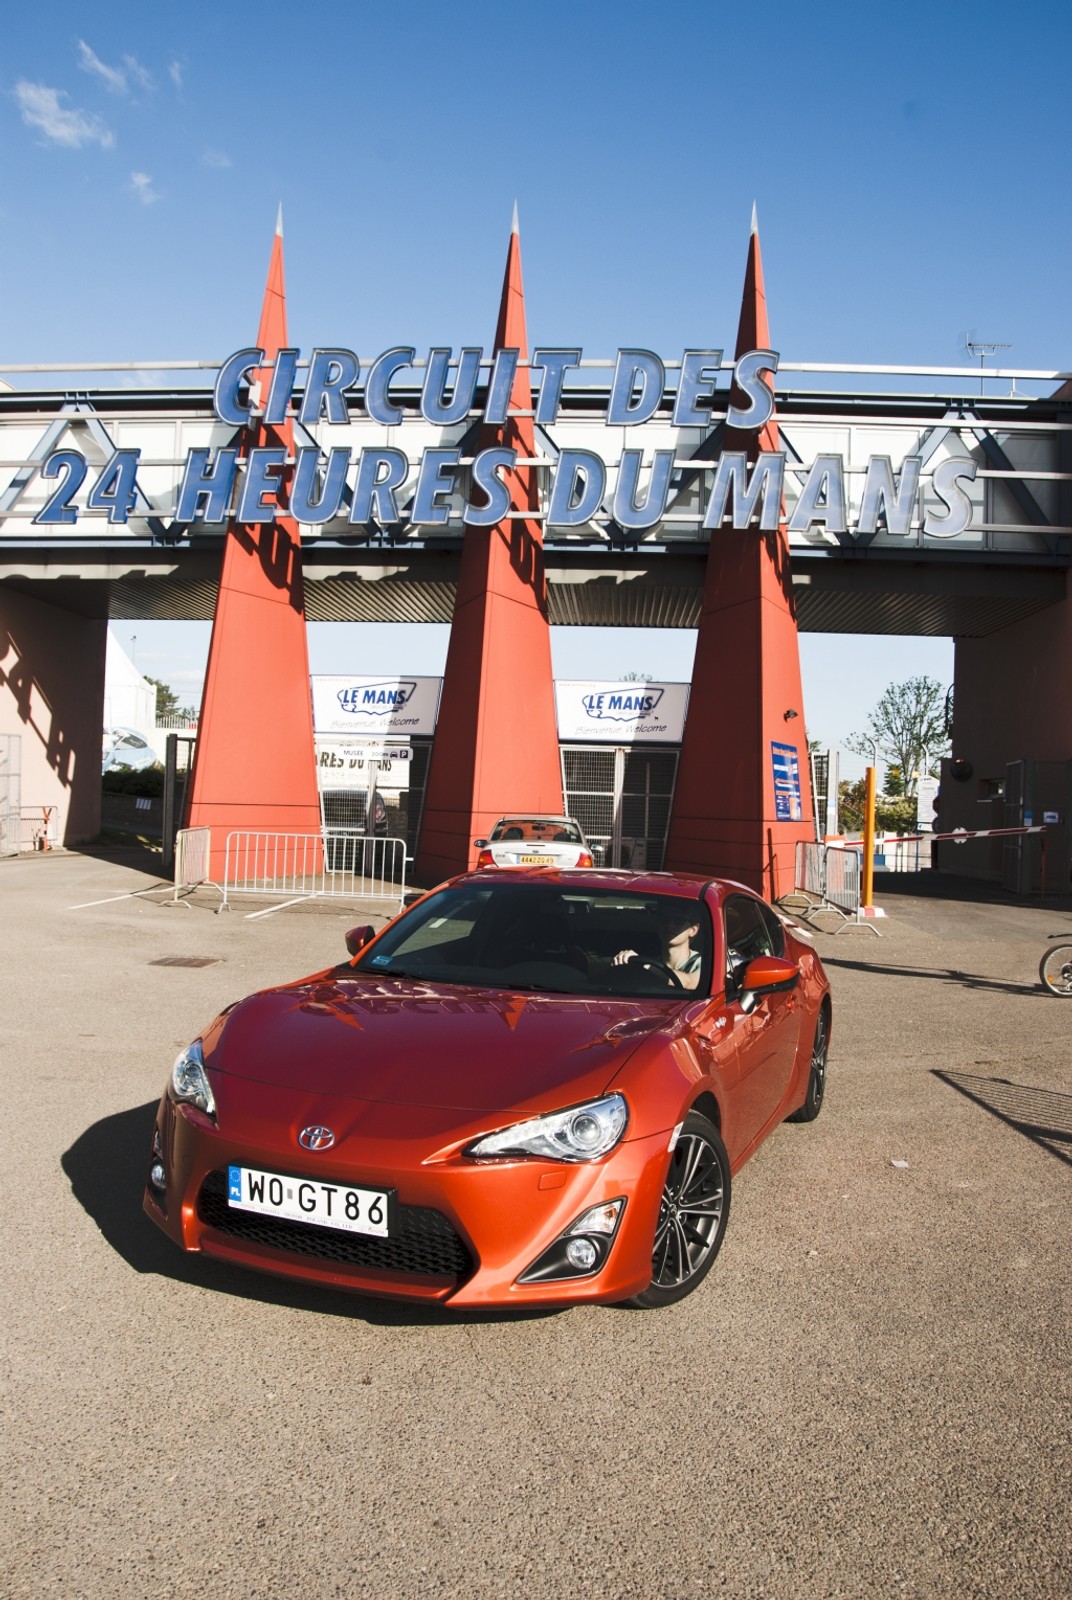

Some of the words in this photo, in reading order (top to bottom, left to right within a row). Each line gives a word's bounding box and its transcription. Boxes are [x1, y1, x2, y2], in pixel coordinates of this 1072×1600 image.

[213, 347, 583, 426] CIRCUIT
[605, 348, 780, 429] DES
[33, 447, 141, 525] 24
[175, 446, 518, 527] HEURES
[546, 448, 676, 529] DU
[702, 450, 978, 538] MANS
[342, 689, 359, 704] LE
[362, 690, 407, 704] MANS
[588, 695, 604, 710] LE
[608, 696, 654, 711] MANS
[231, 1186, 241, 1196] PL
[248, 1172, 284, 1207] WO
[298, 1183, 384, 1225] GT86
